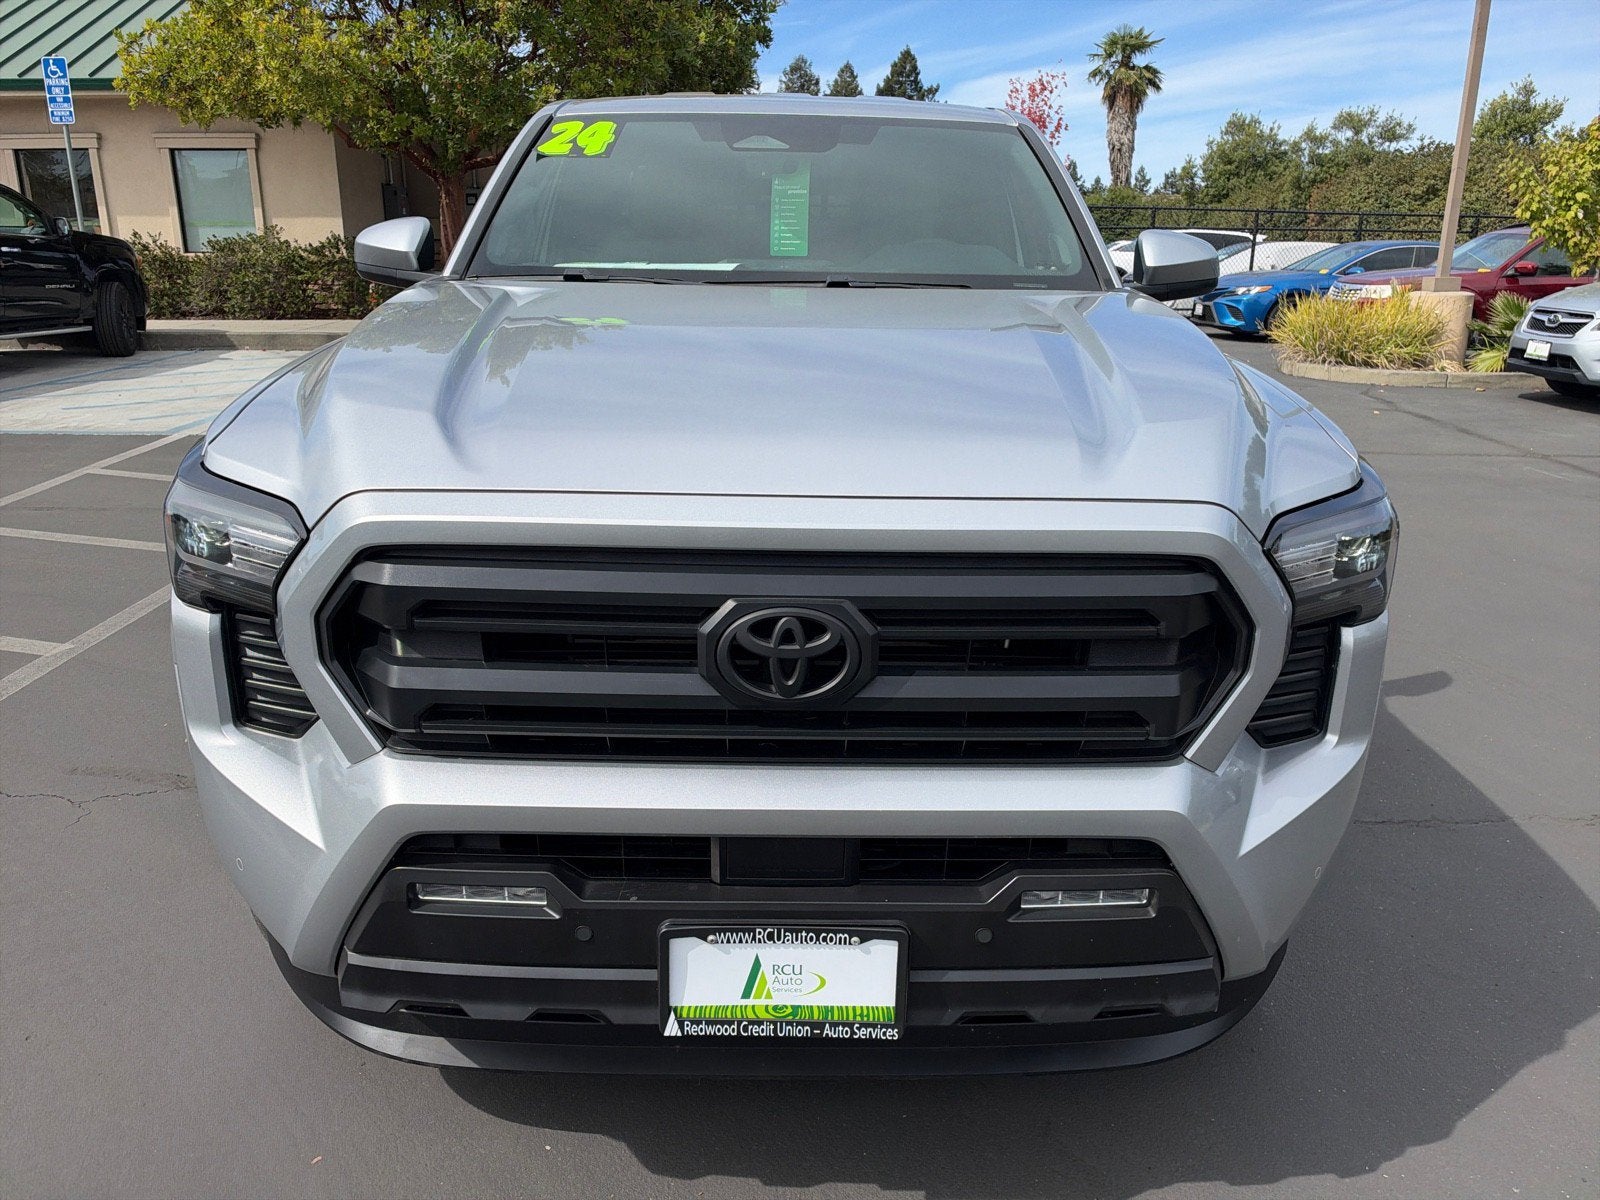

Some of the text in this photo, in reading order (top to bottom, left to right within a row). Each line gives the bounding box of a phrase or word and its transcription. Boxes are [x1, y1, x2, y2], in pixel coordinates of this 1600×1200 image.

[46, 78, 68, 86] PARKING
[51, 86, 64, 95] ONLY
[537, 120, 617, 156] 24
[716, 928, 850, 945] www.RCUauto.com
[772, 964, 803, 976] RCU
[772, 976, 803, 986] Auto
[684, 1021, 737, 1036] Redwood
[740, 1021, 774, 1037] Credit
[777, 1022, 811, 1037] Union
[822, 1023, 851, 1038] Auto
[853, 1024, 899, 1040] Services
